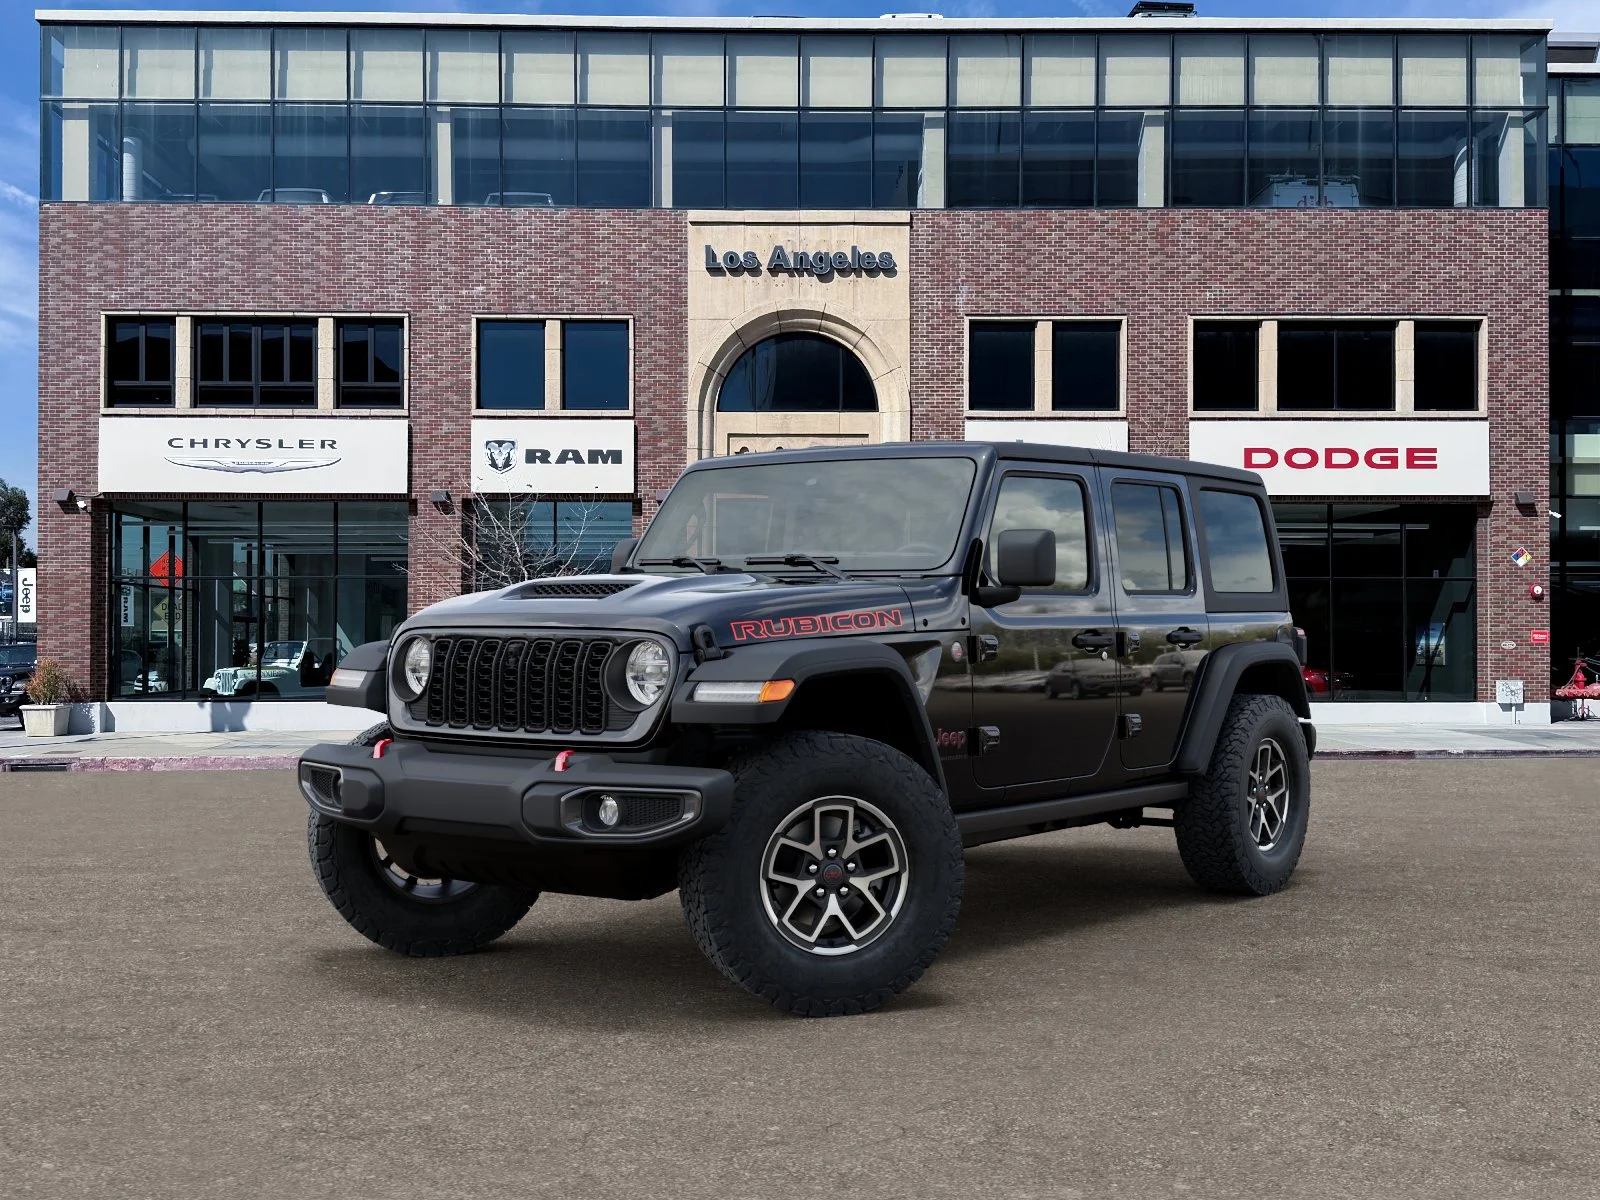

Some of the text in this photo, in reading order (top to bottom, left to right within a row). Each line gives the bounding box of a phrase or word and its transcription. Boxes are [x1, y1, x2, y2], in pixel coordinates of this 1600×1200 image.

[705, 244, 894, 276] Los Angeles
[167, 437, 338, 450] CHRYSLER
[525, 448, 623, 465] RAM
[1243, 447, 1438, 470] DODGE
[20, 577, 33, 613] Jeep
[161, 602, 183, 611] DAD
[165, 612, 181, 620] ED
[730, 609, 903, 641] RUBICON
[936, 728, 966, 749] Jeep
